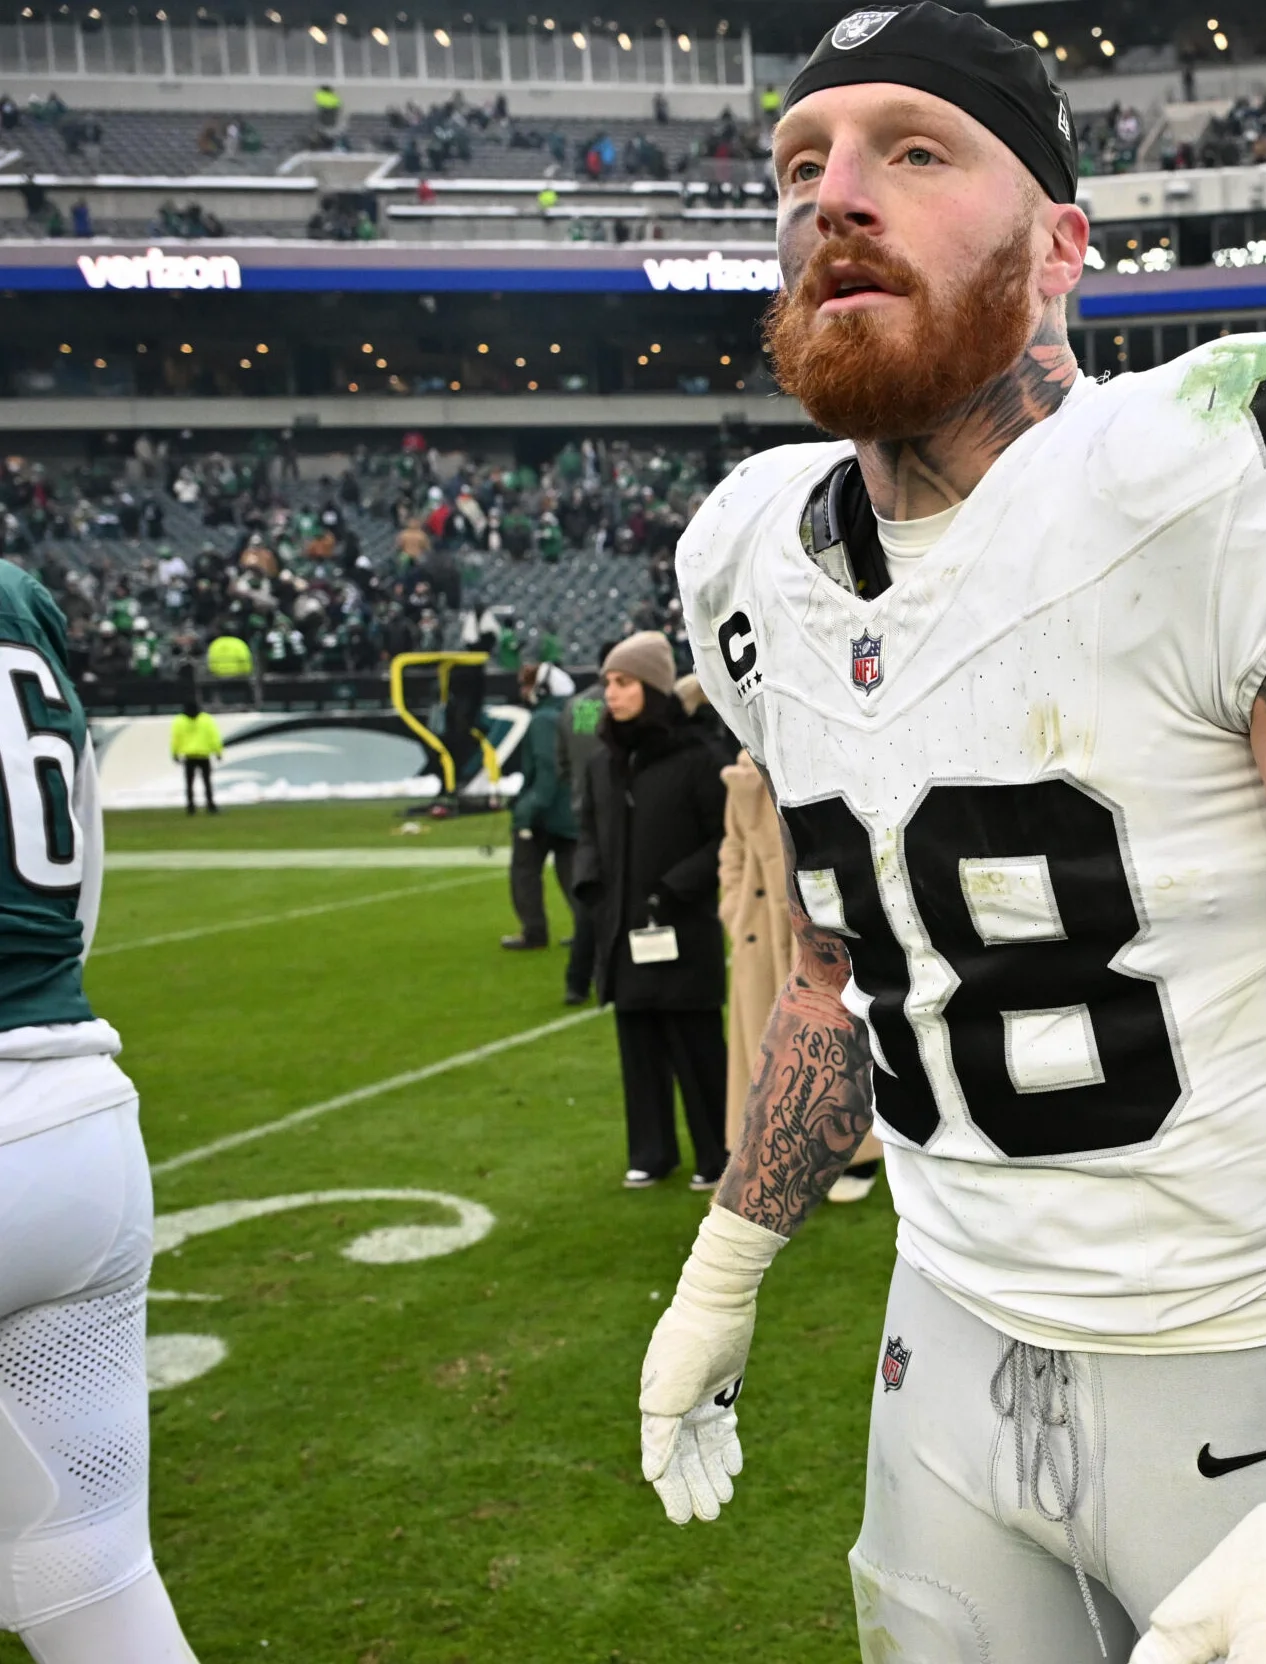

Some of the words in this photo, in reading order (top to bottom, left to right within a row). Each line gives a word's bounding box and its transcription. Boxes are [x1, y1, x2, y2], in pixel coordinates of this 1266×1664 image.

[77, 247, 241, 289] verizon
[718, 611, 757, 683] C
[854, 657, 879, 684] NFL
[883, 1353, 900, 1383] NFL
